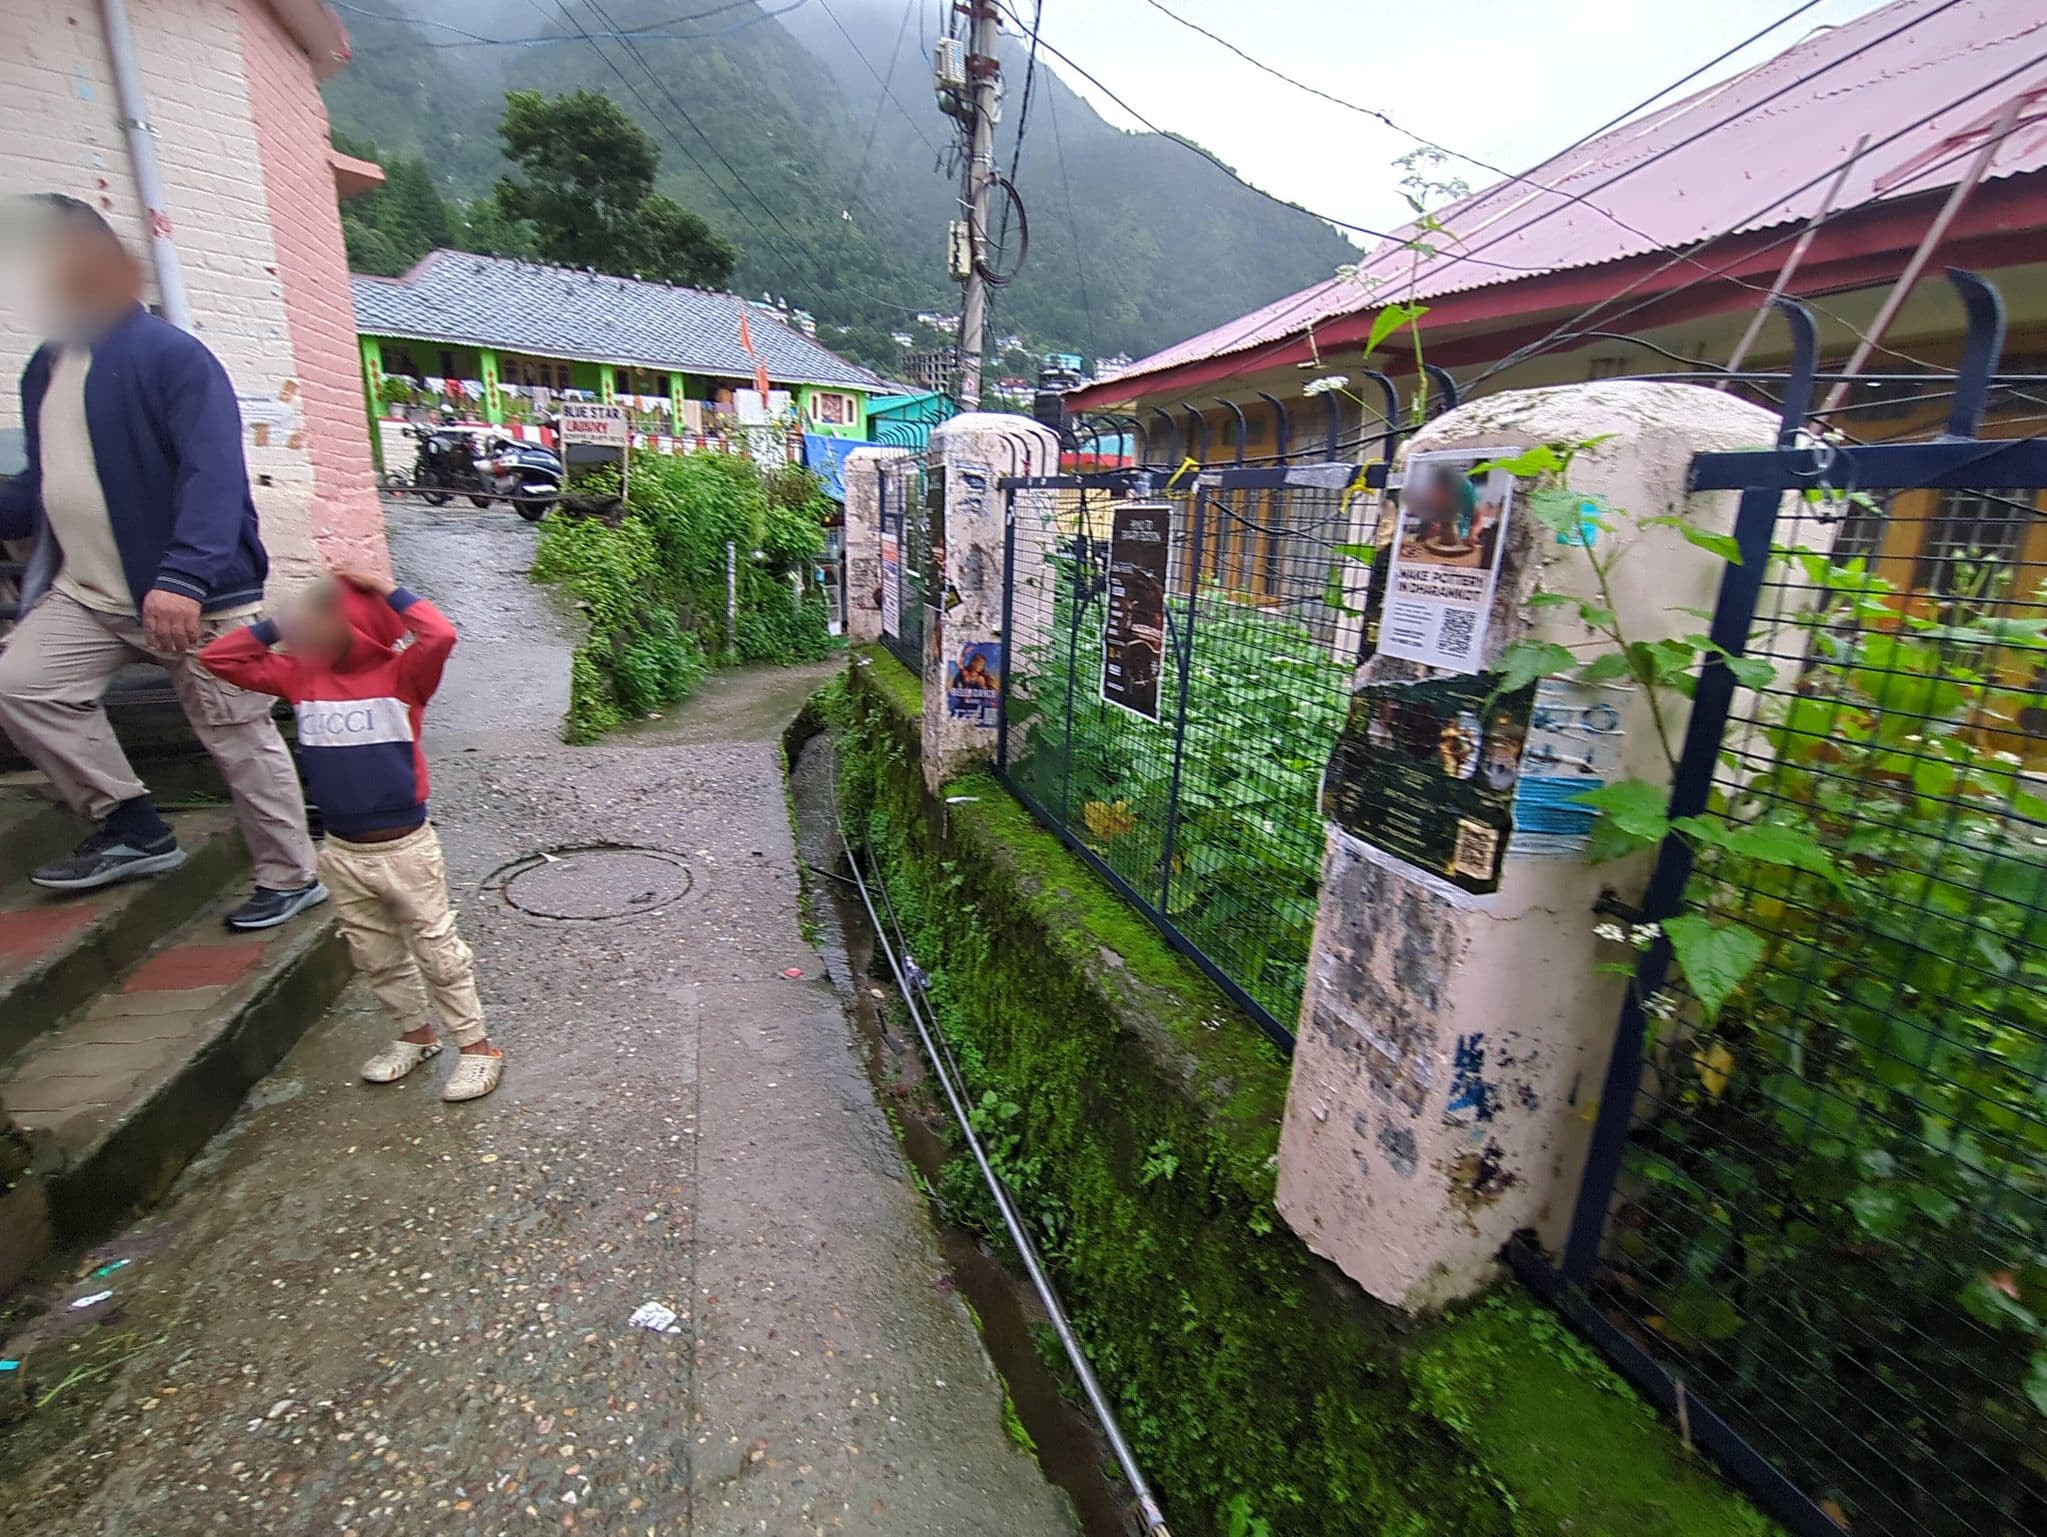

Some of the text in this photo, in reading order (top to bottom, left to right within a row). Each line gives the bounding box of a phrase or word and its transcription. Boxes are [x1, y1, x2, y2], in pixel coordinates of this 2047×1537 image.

[564, 406, 620, 419] BLUE STAR
[1397, 569, 1485, 587] MAKE POTTERY
